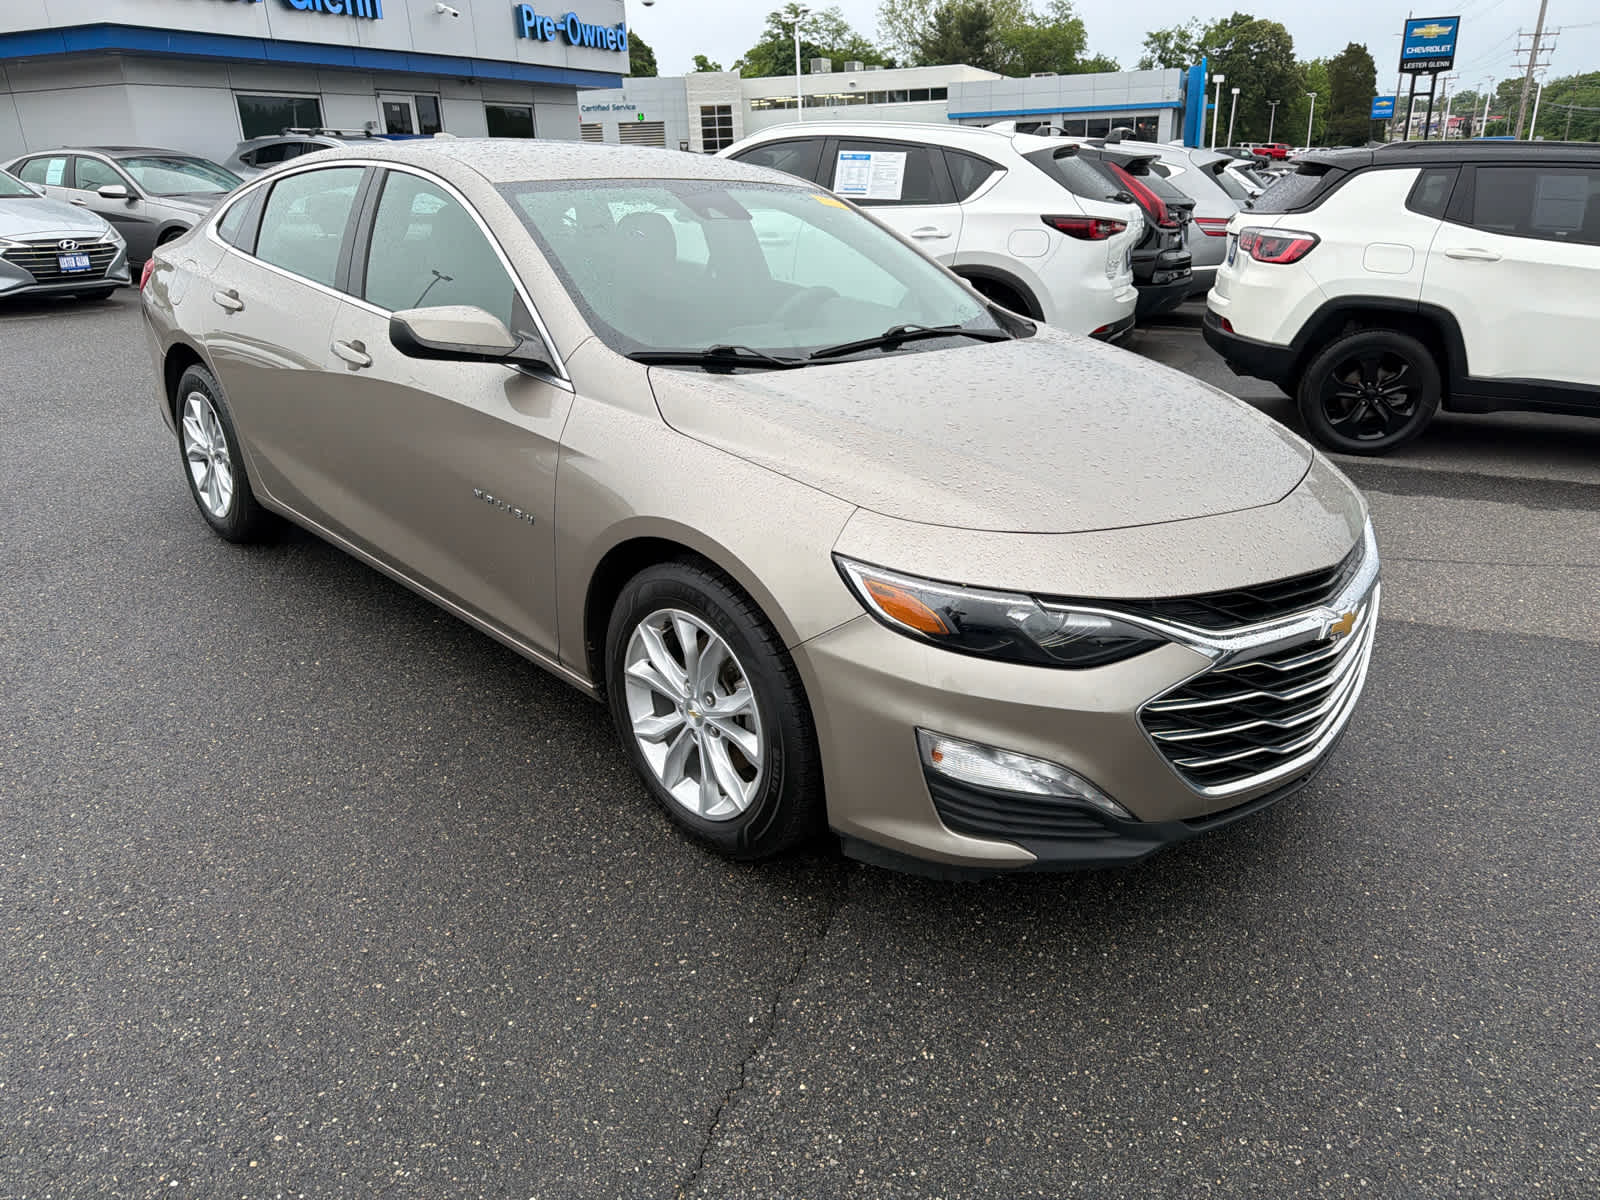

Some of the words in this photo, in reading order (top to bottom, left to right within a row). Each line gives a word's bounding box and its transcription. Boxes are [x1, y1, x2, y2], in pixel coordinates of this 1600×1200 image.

[518, 4, 628, 52] Pre-Owned
[1406, 44, 1452, 54] CHEVROLET
[581, 104, 610, 112] Certified
